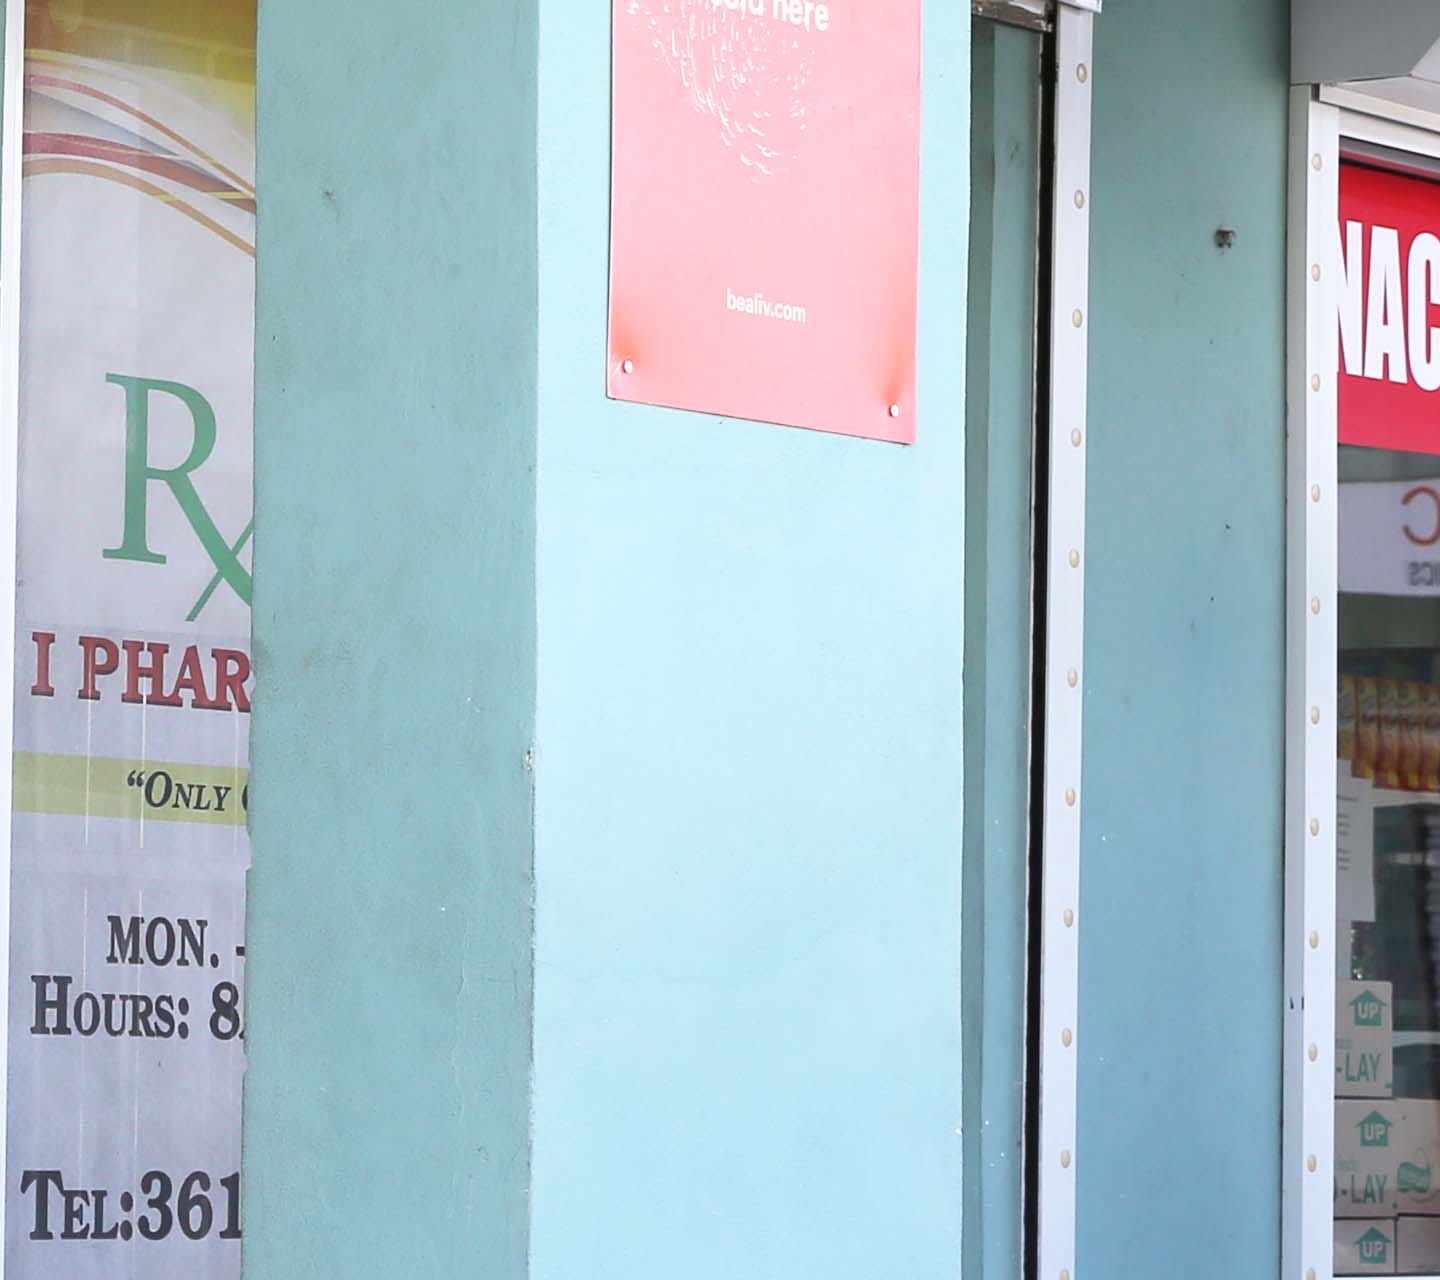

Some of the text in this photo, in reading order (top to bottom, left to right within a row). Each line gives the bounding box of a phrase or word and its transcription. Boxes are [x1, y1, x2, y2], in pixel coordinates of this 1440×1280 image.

[726, 287, 806, 323] bealiv.com
[31, 631, 251, 713] I PHAR
[106, 914, 220, 969] MON.
[30, 974, 244, 1041] HOURS: 8
[1357, 1000, 1378, 1020] UP
[1364, 1122, 1386, 1142] UP
[20, 1170, 242, 1241] TEL:361
[1334, 1173, 1388, 1205] -LAY
[1361, 1239, 1384, 1259] UP
